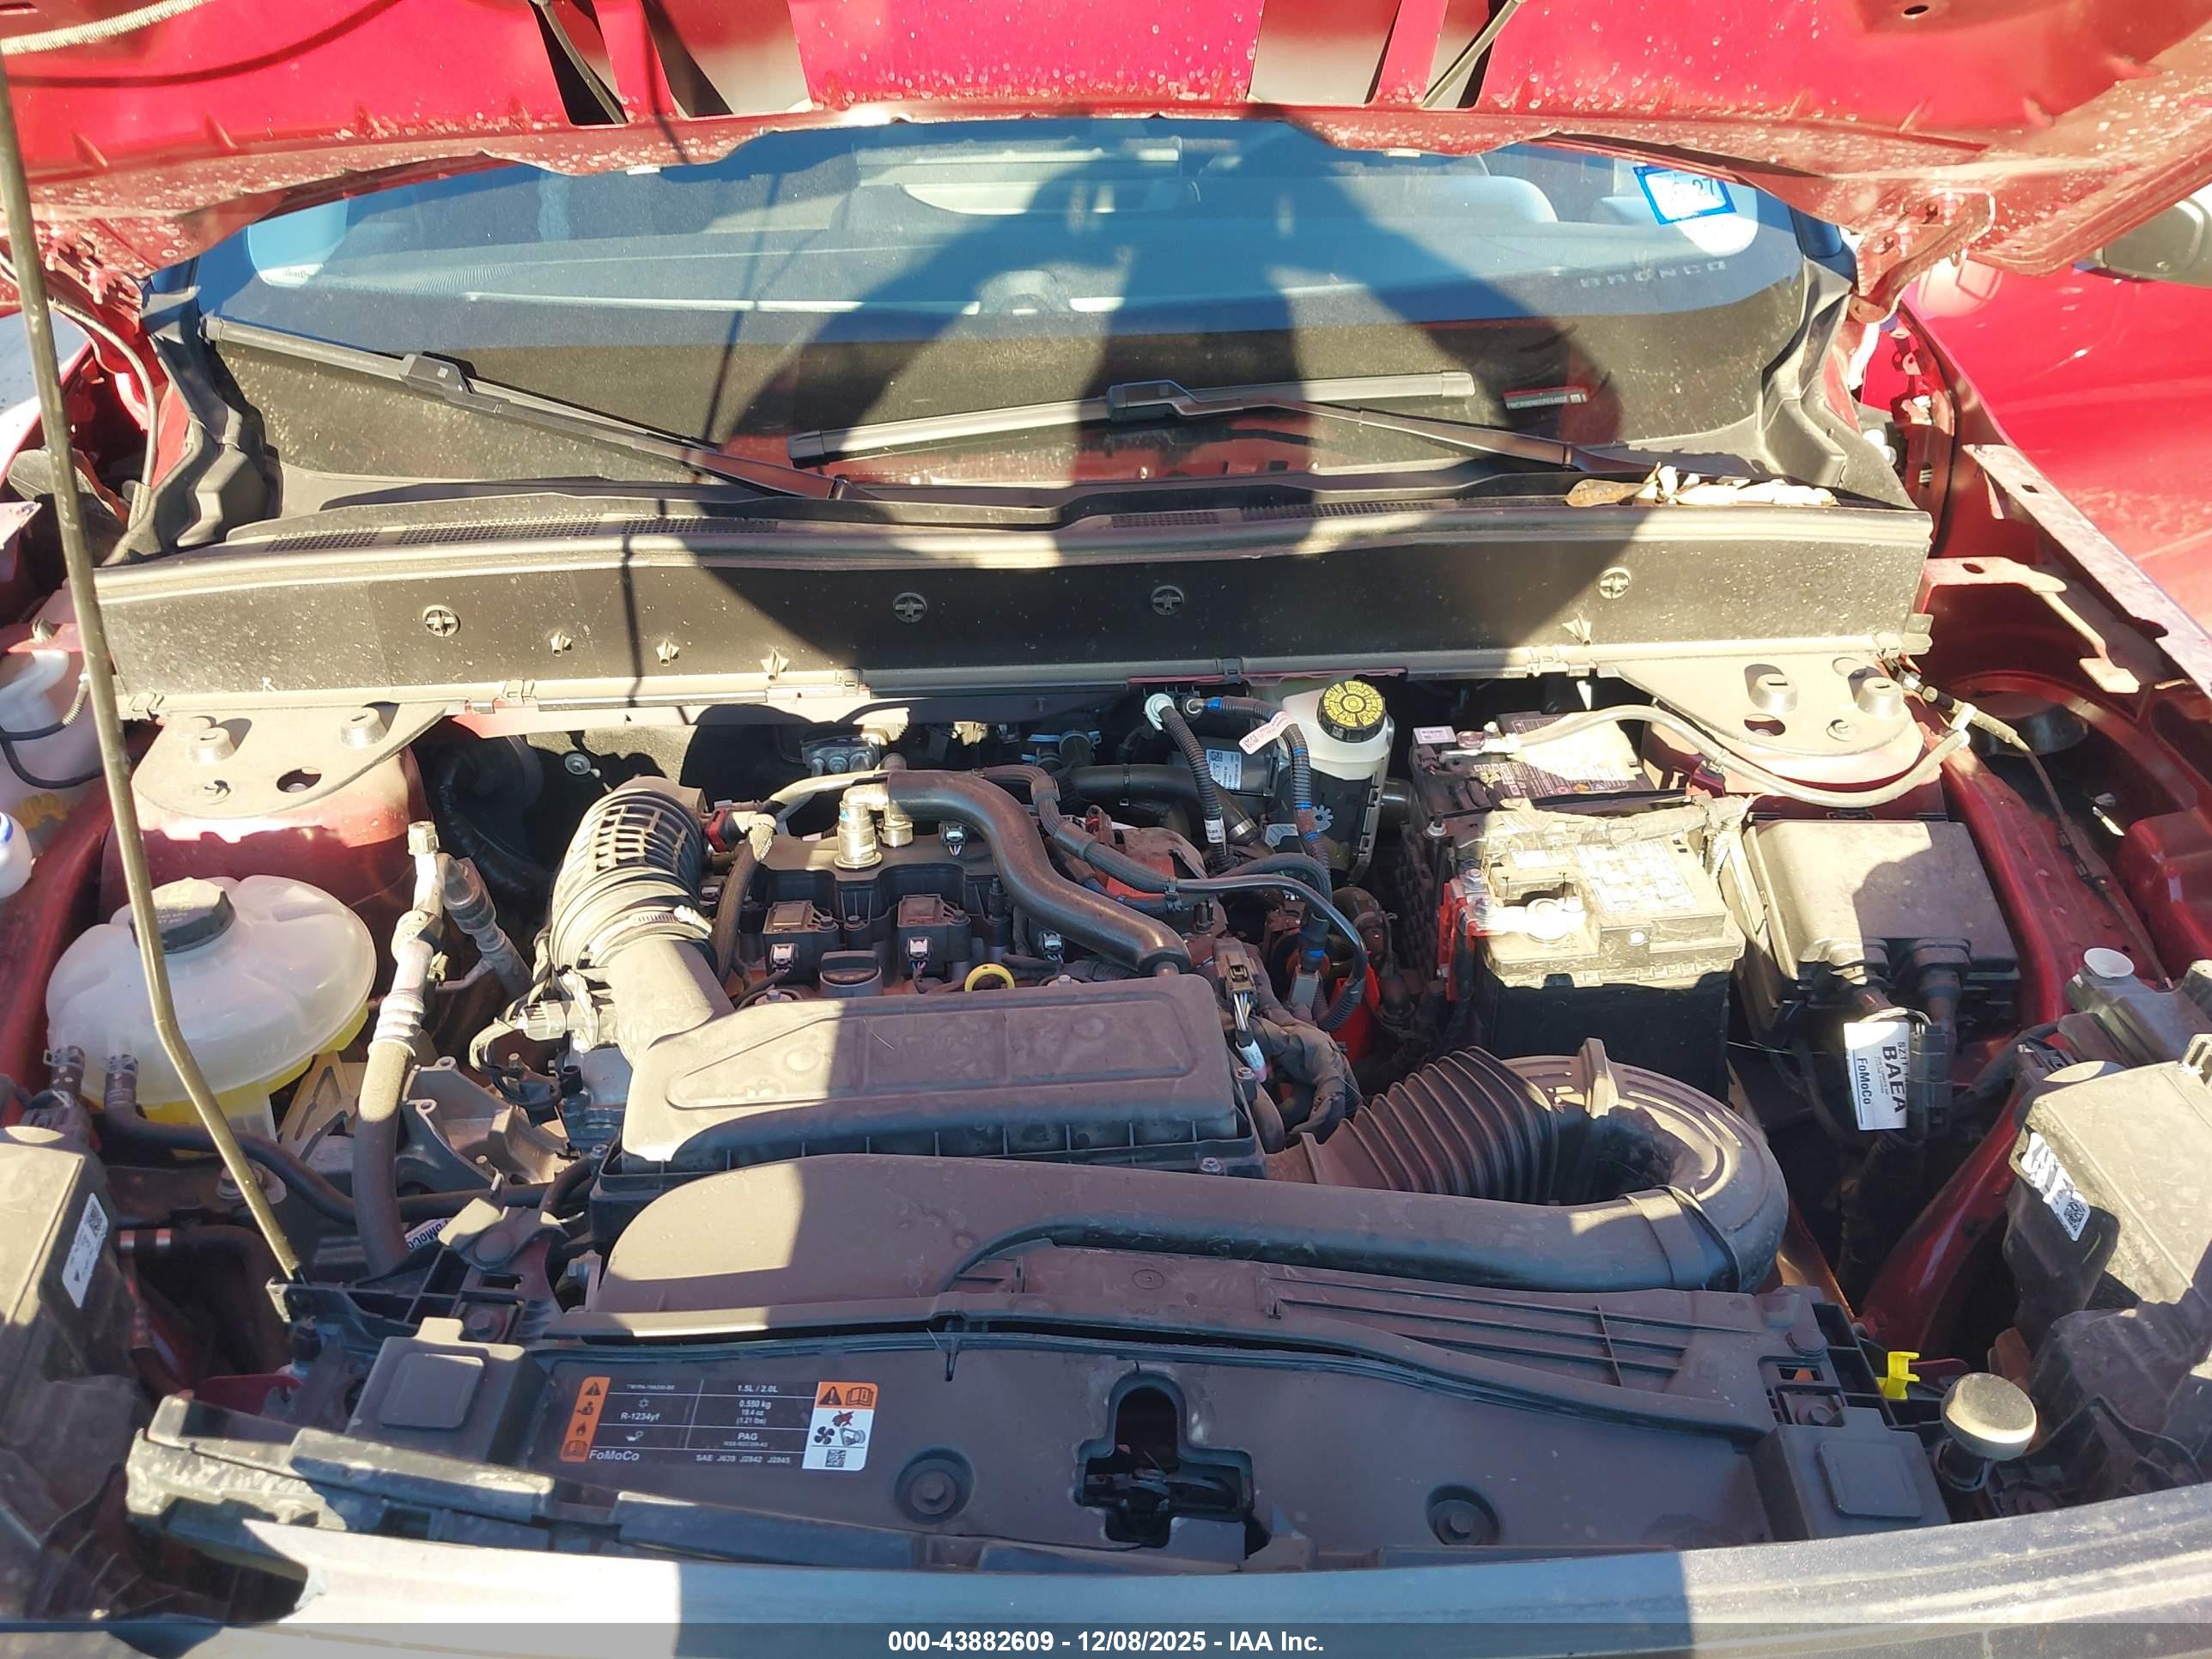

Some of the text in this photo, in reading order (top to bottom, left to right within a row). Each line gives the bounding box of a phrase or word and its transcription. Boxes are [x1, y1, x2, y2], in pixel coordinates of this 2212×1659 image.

[1579, 260, 1727, 289] BRONCO
[1856, 1057, 1872, 1105] FoMoCo
[1881, 1046, 1906, 1114] BAEA
[761, 1400, 772, 1410] kg
[620, 1412, 660, 1422] R-1234yf
[738, 1432, 758, 1441] PAG
[588, 1449, 640, 1461] FoMoCo
[696, 1454, 714, 1462] SAE
